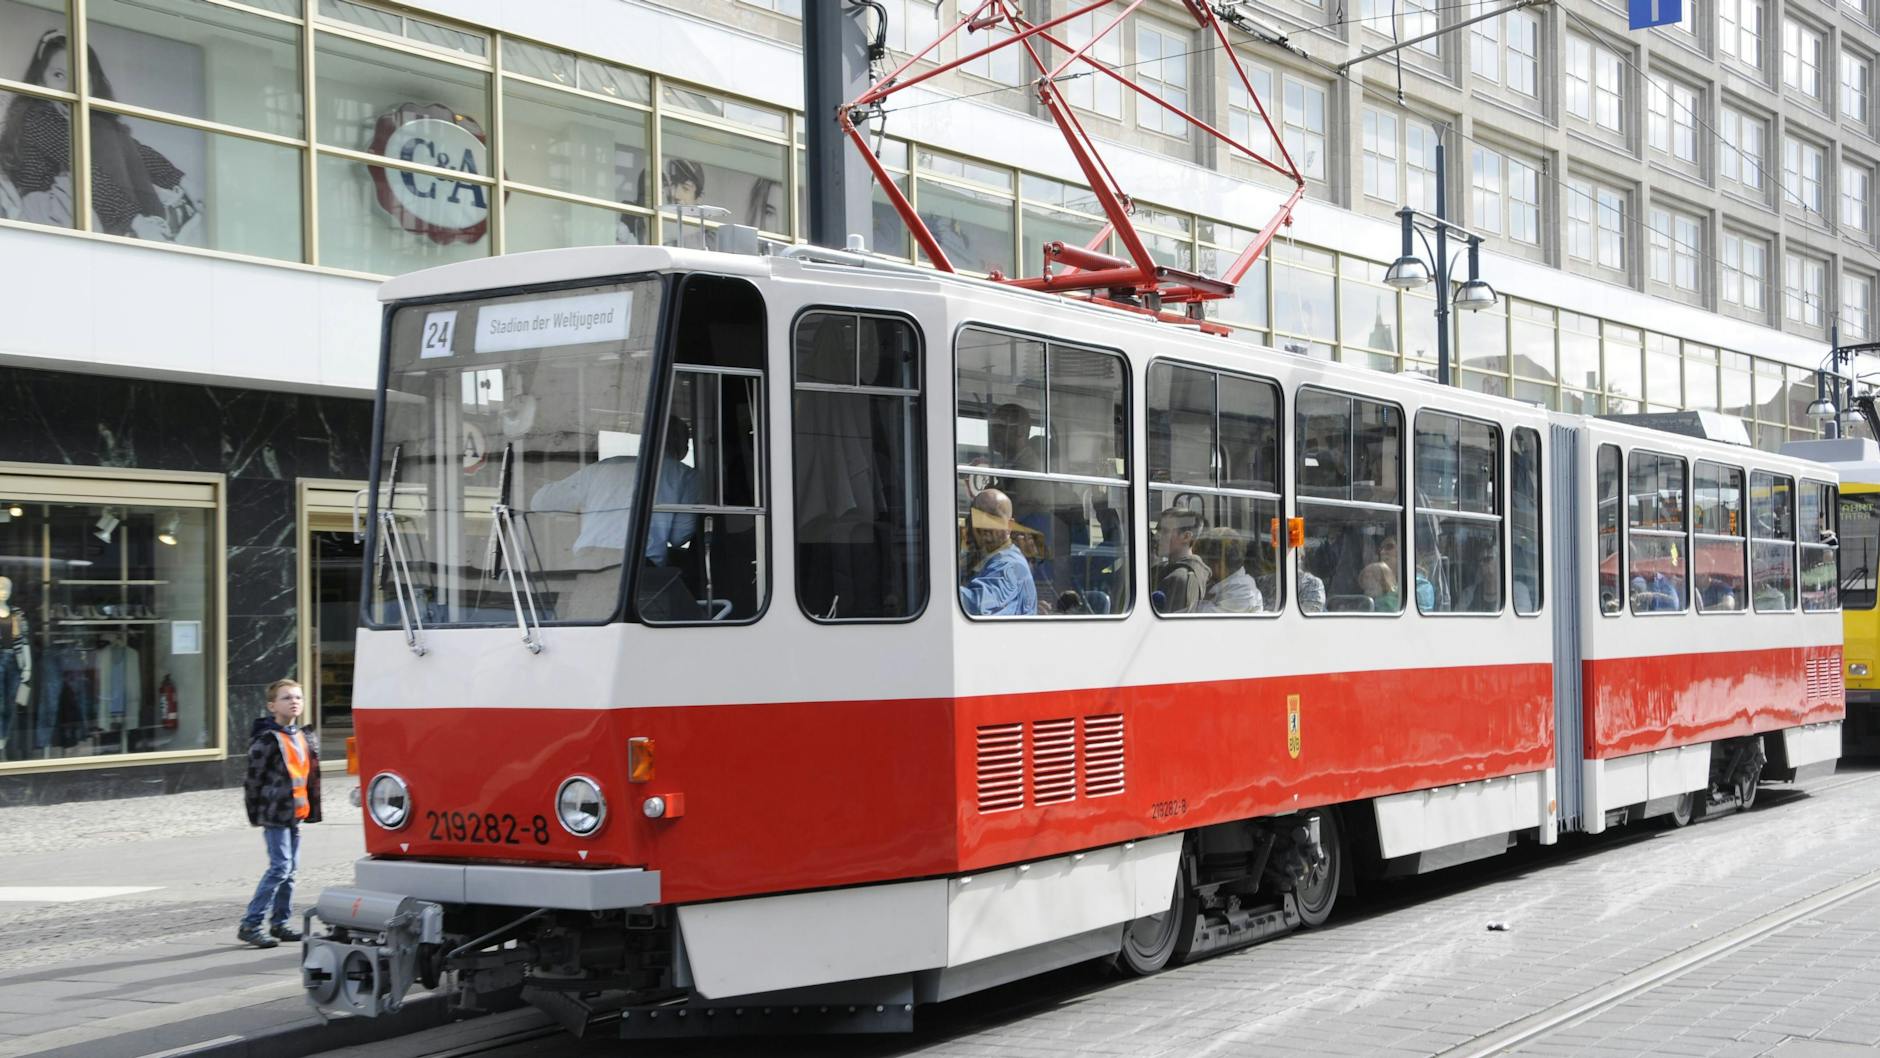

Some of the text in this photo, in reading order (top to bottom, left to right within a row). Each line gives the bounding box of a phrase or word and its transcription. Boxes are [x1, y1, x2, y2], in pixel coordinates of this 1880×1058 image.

[400, 138, 487, 209] C&A
[427, 321, 450, 348] 24
[490, 308, 615, 335] Stadion der Weltjugend
[1152, 799, 1187, 819] 219282-8
[427, 811, 550, 845] 219282-8
